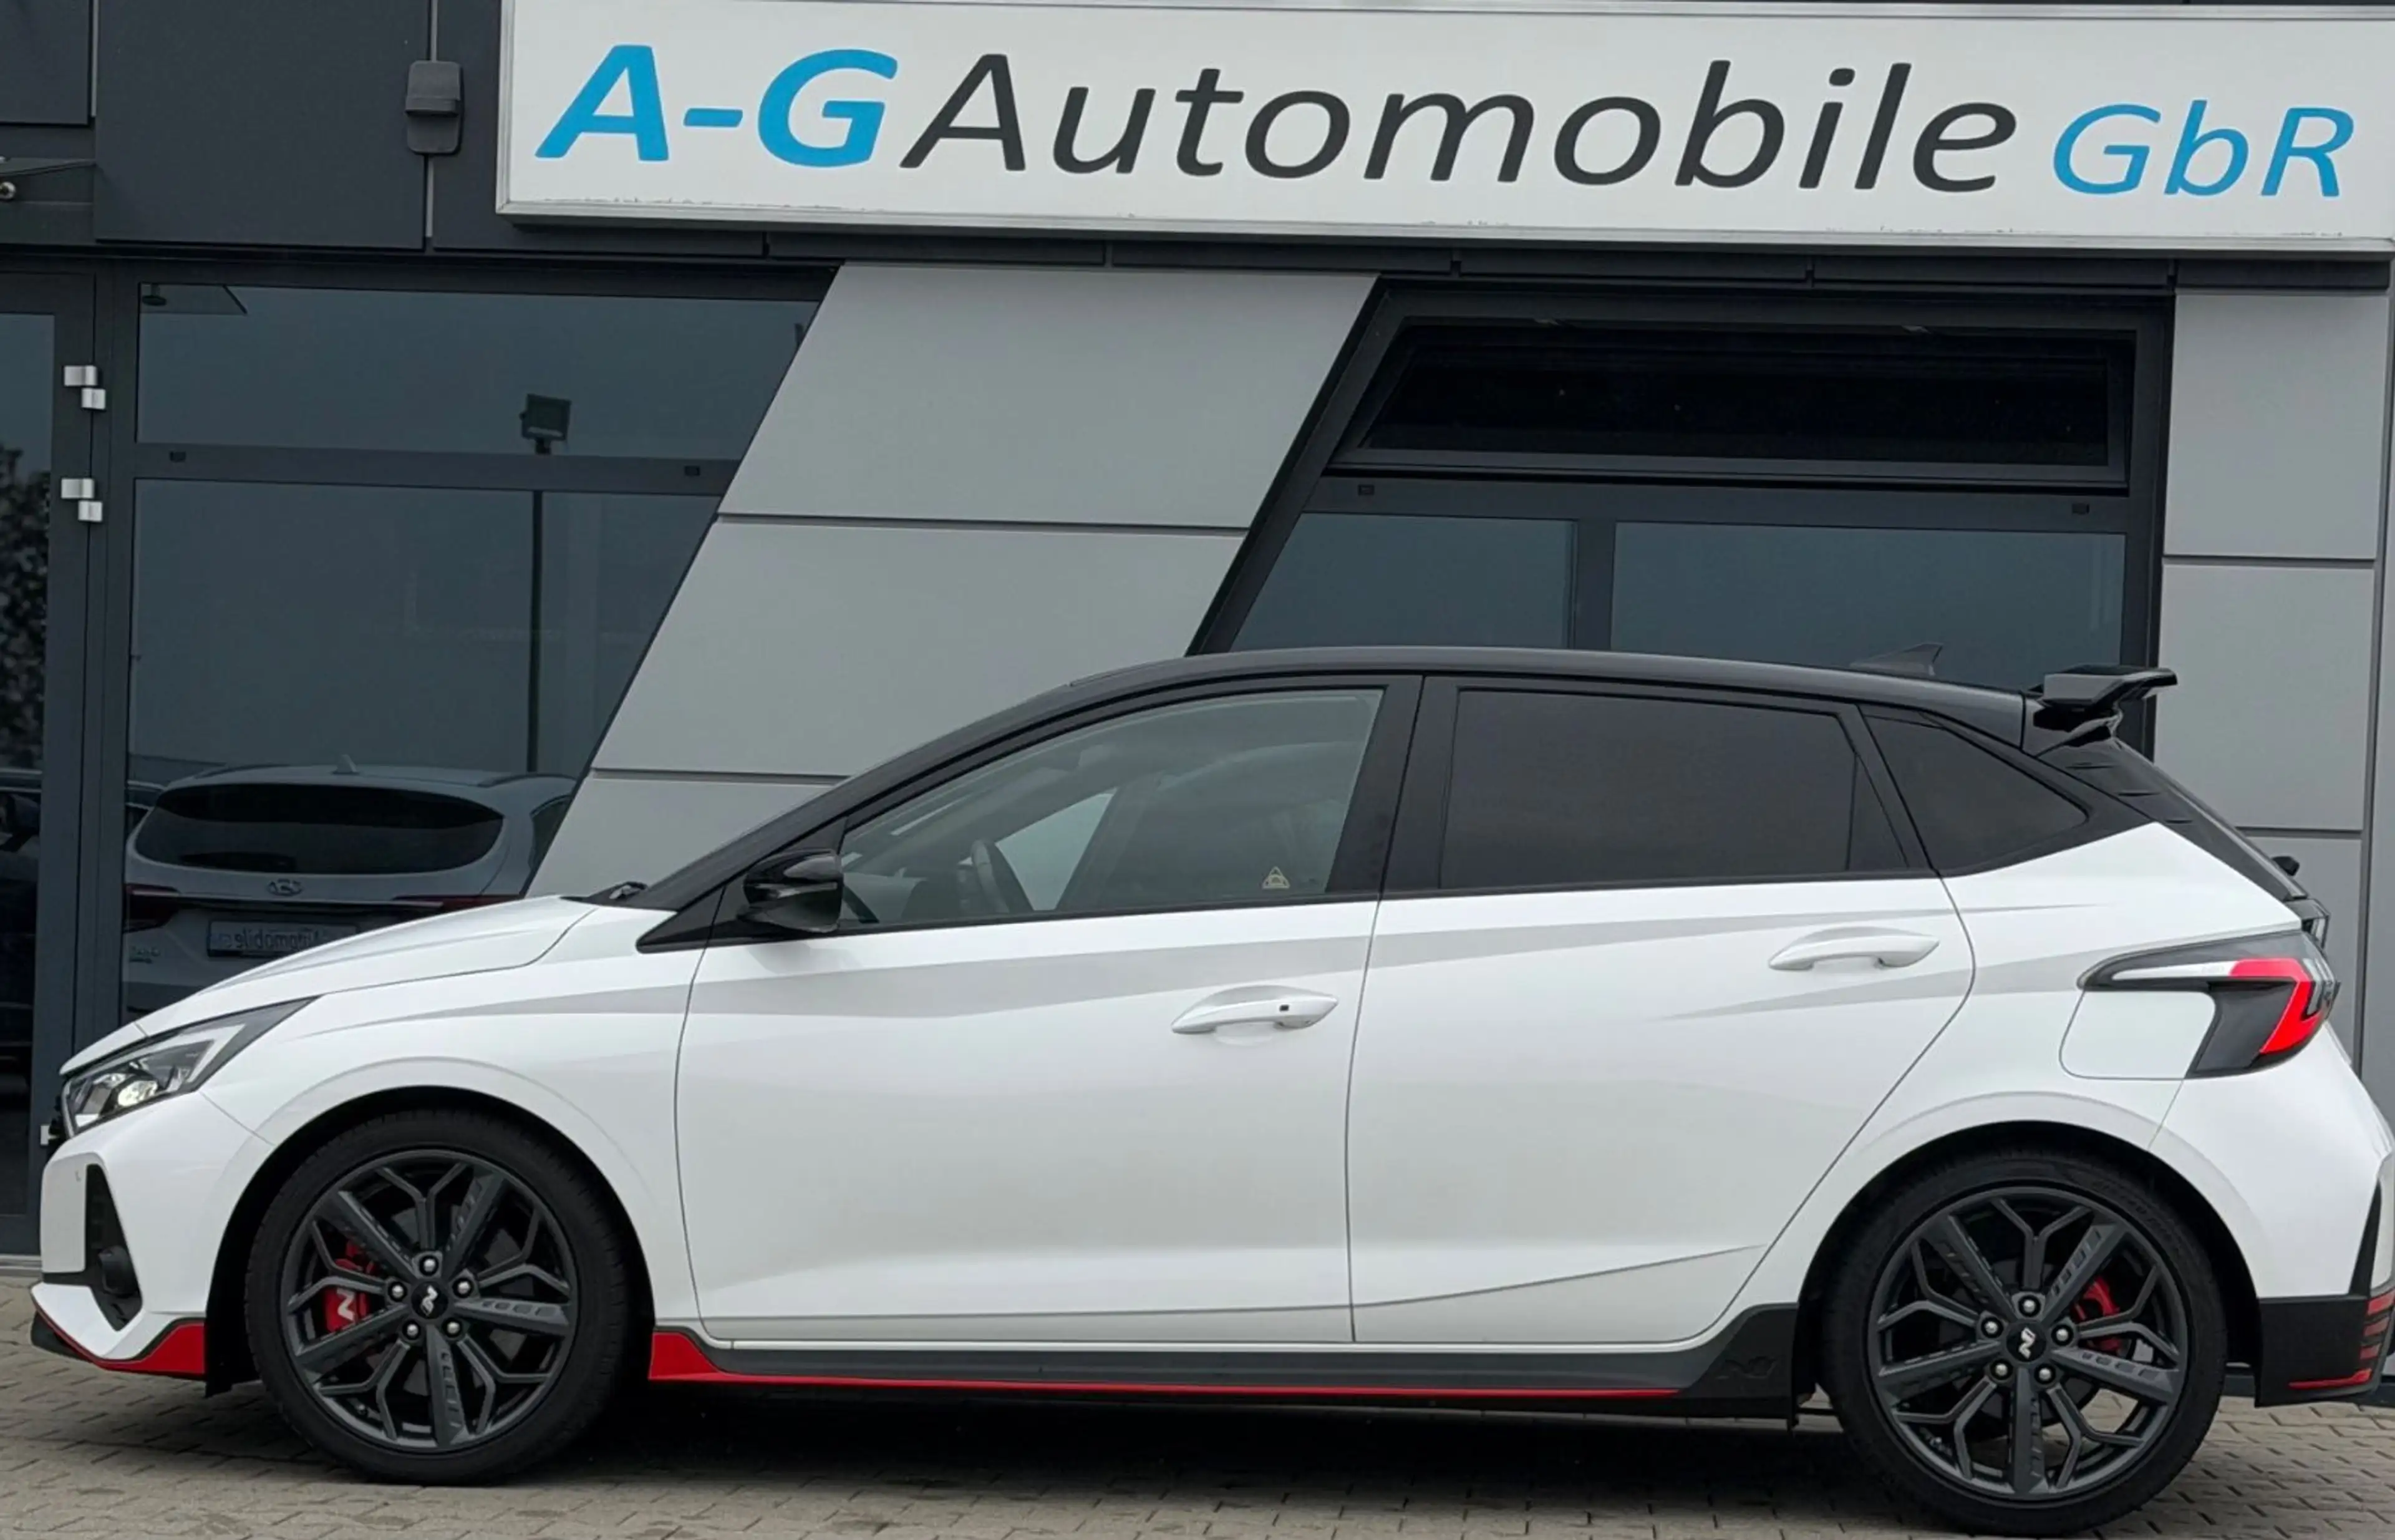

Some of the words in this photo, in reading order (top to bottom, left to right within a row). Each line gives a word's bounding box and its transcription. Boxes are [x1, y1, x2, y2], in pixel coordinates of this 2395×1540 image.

[536, 44, 898, 168] A-G
[899, 53, 2016, 193] Automobile
[2053, 99, 2354, 198] GbR
